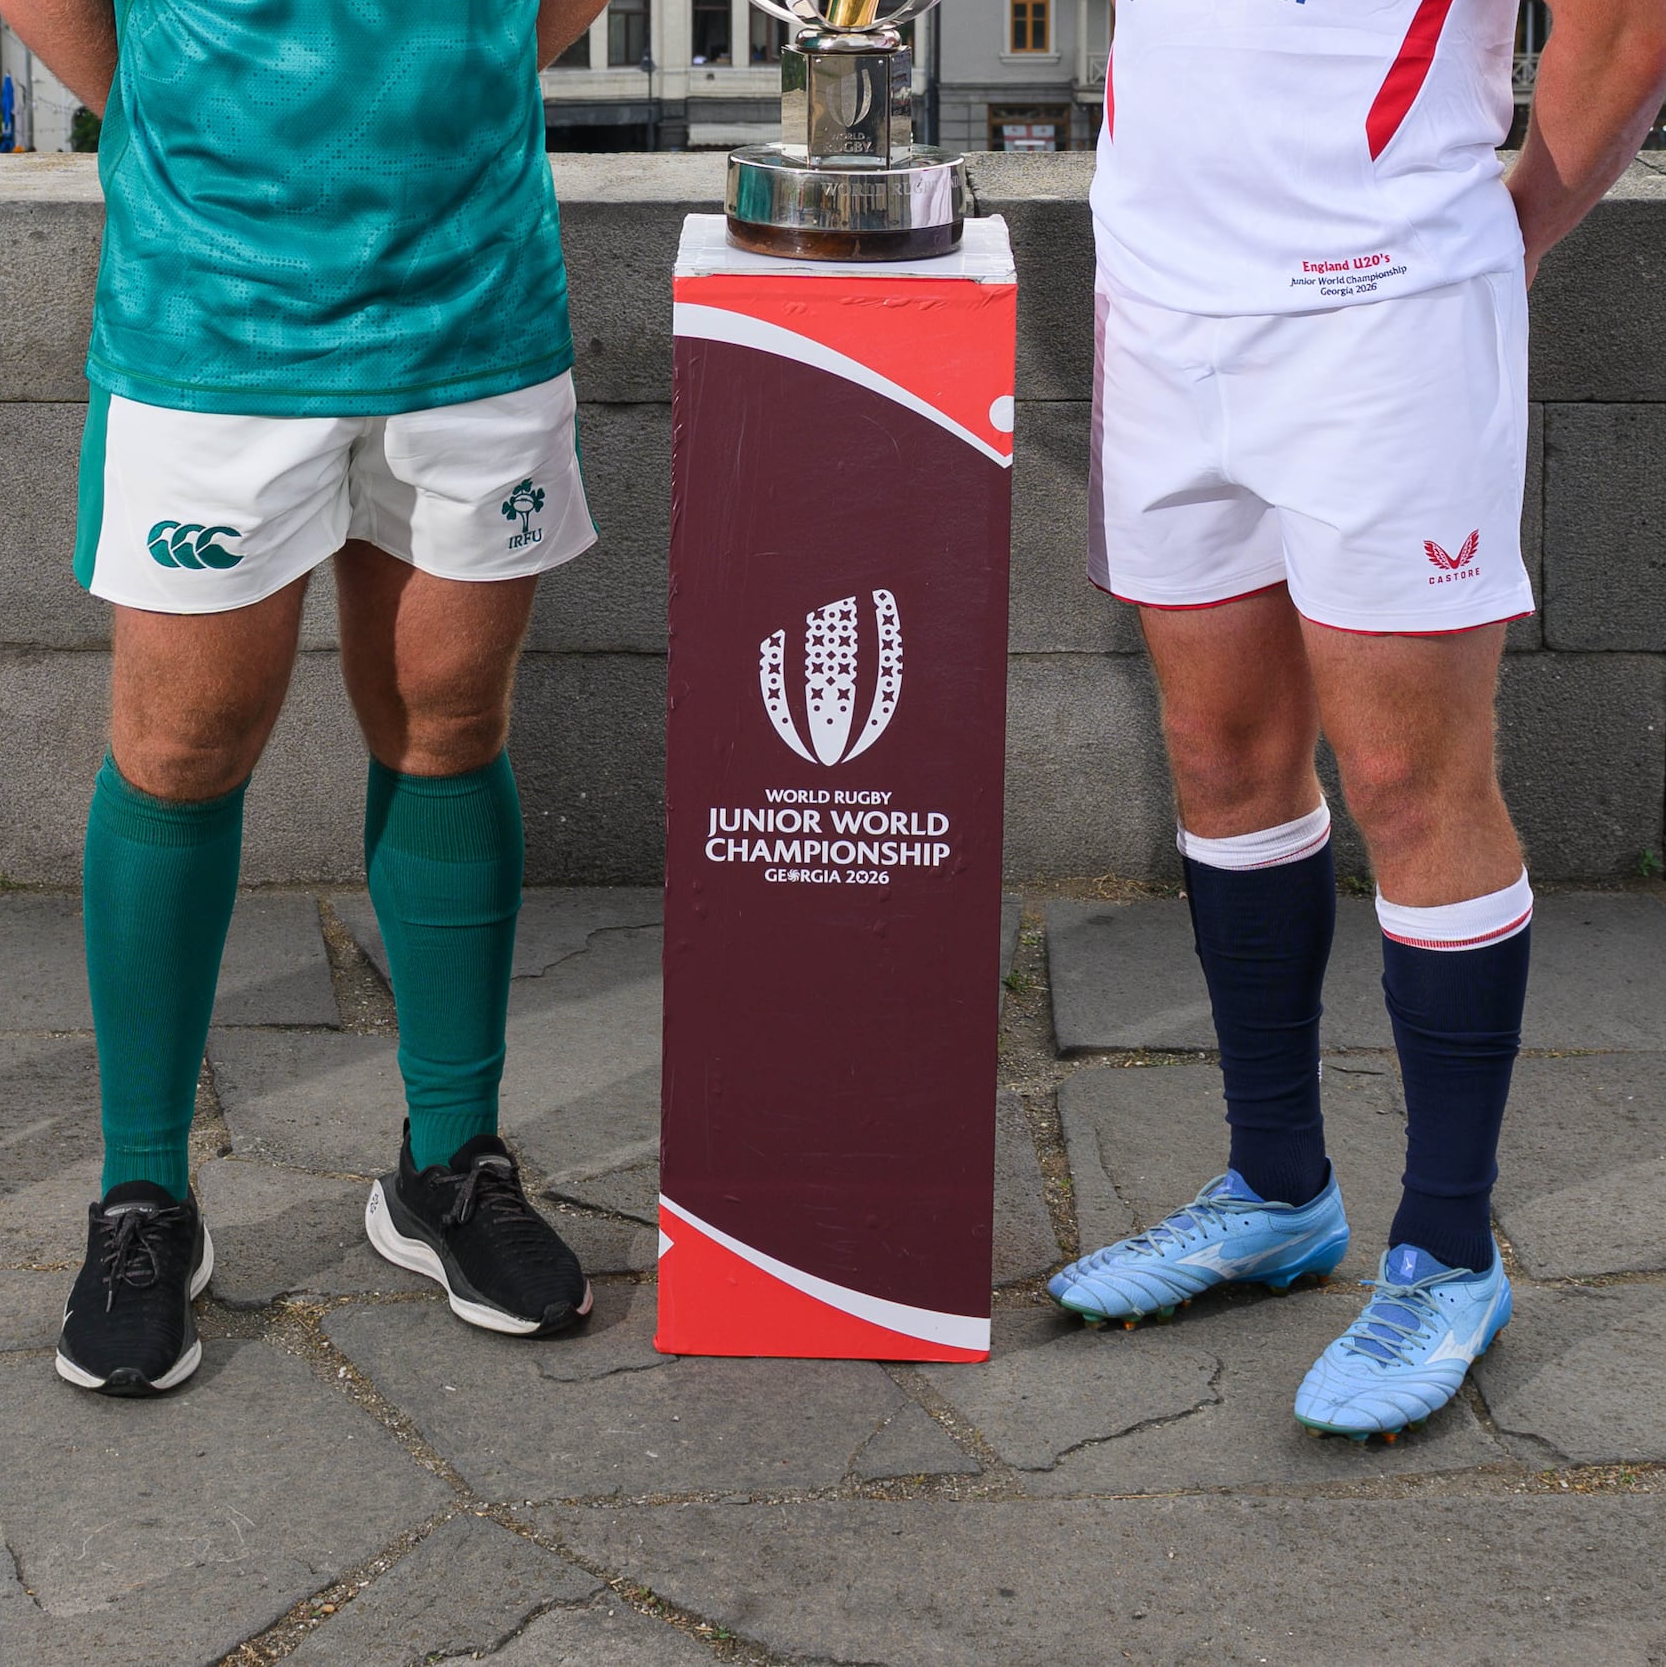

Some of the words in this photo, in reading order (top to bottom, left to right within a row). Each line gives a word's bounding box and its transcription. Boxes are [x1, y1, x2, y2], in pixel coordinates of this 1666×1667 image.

[1302, 260, 1350, 274] England
[1353, 253, 1391, 269] U20's
[1290, 277, 1316, 287] Junior
[1318, 276, 1345, 286] World
[1346, 265, 1407, 284] Championship
[1320, 286, 1353, 297] Georgia
[1355, 282, 1378, 294] 2026
[508, 527, 543, 549] IRFU
[1428, 567, 1481, 585] CASTORE
[765, 788, 831, 804] WORLD
[834, 790, 892, 805] RUGBY
[707, 807, 823, 838] JUNIOR
[830, 810, 950, 836] WORLD
[705, 837, 951, 867] CHAMPIONSHIP
[764, 868, 841, 884] GEORGIA
[845, 869, 890, 885] 2026
